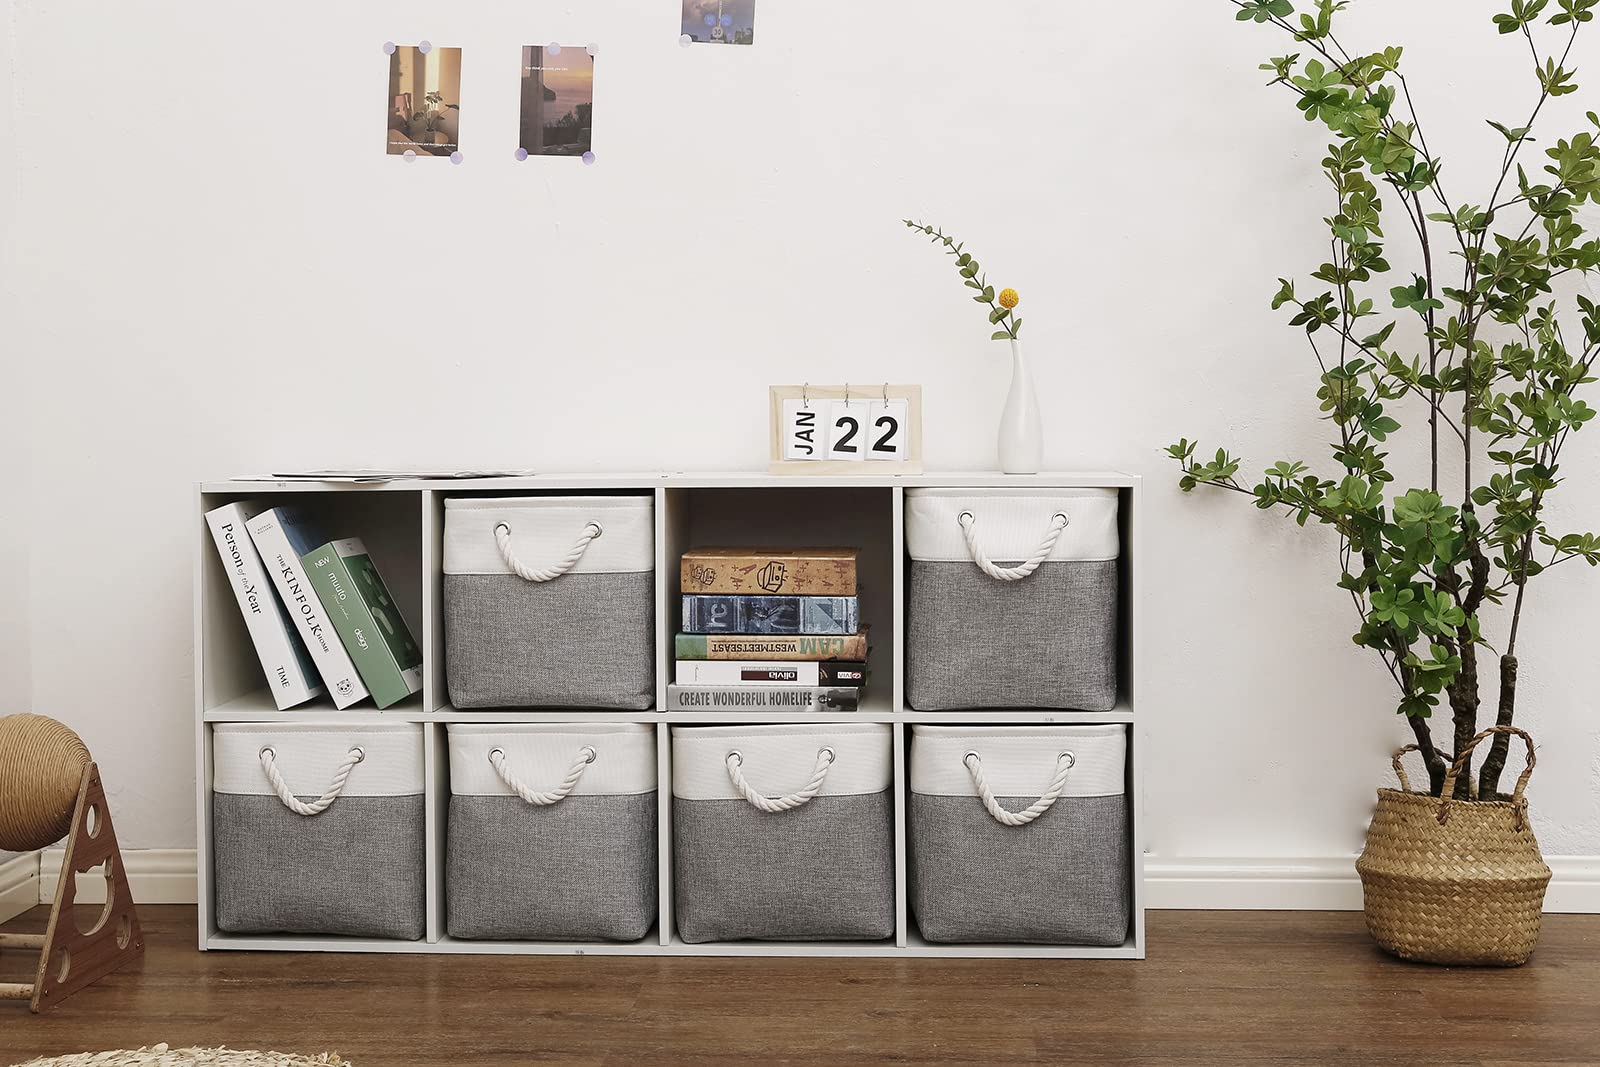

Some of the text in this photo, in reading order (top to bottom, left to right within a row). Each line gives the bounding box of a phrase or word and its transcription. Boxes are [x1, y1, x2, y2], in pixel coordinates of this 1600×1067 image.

[794, 412, 898, 455] JAN 2 2
[221, 523, 262, 615] Person of the Year
[314, 556, 331, 568] NEW
[328, 572, 346, 601] muuto
[276, 554, 330, 653] THE KINFOLK HOME
[354, 628, 369, 651] design
[712, 638, 844, 655] CAM WESTMEETSEAST
[276, 665, 290, 688] TIME
[769, 671, 795, 679] olivia
[679, 692, 812, 706] CREATE WONDERFUL HOMELIFE
